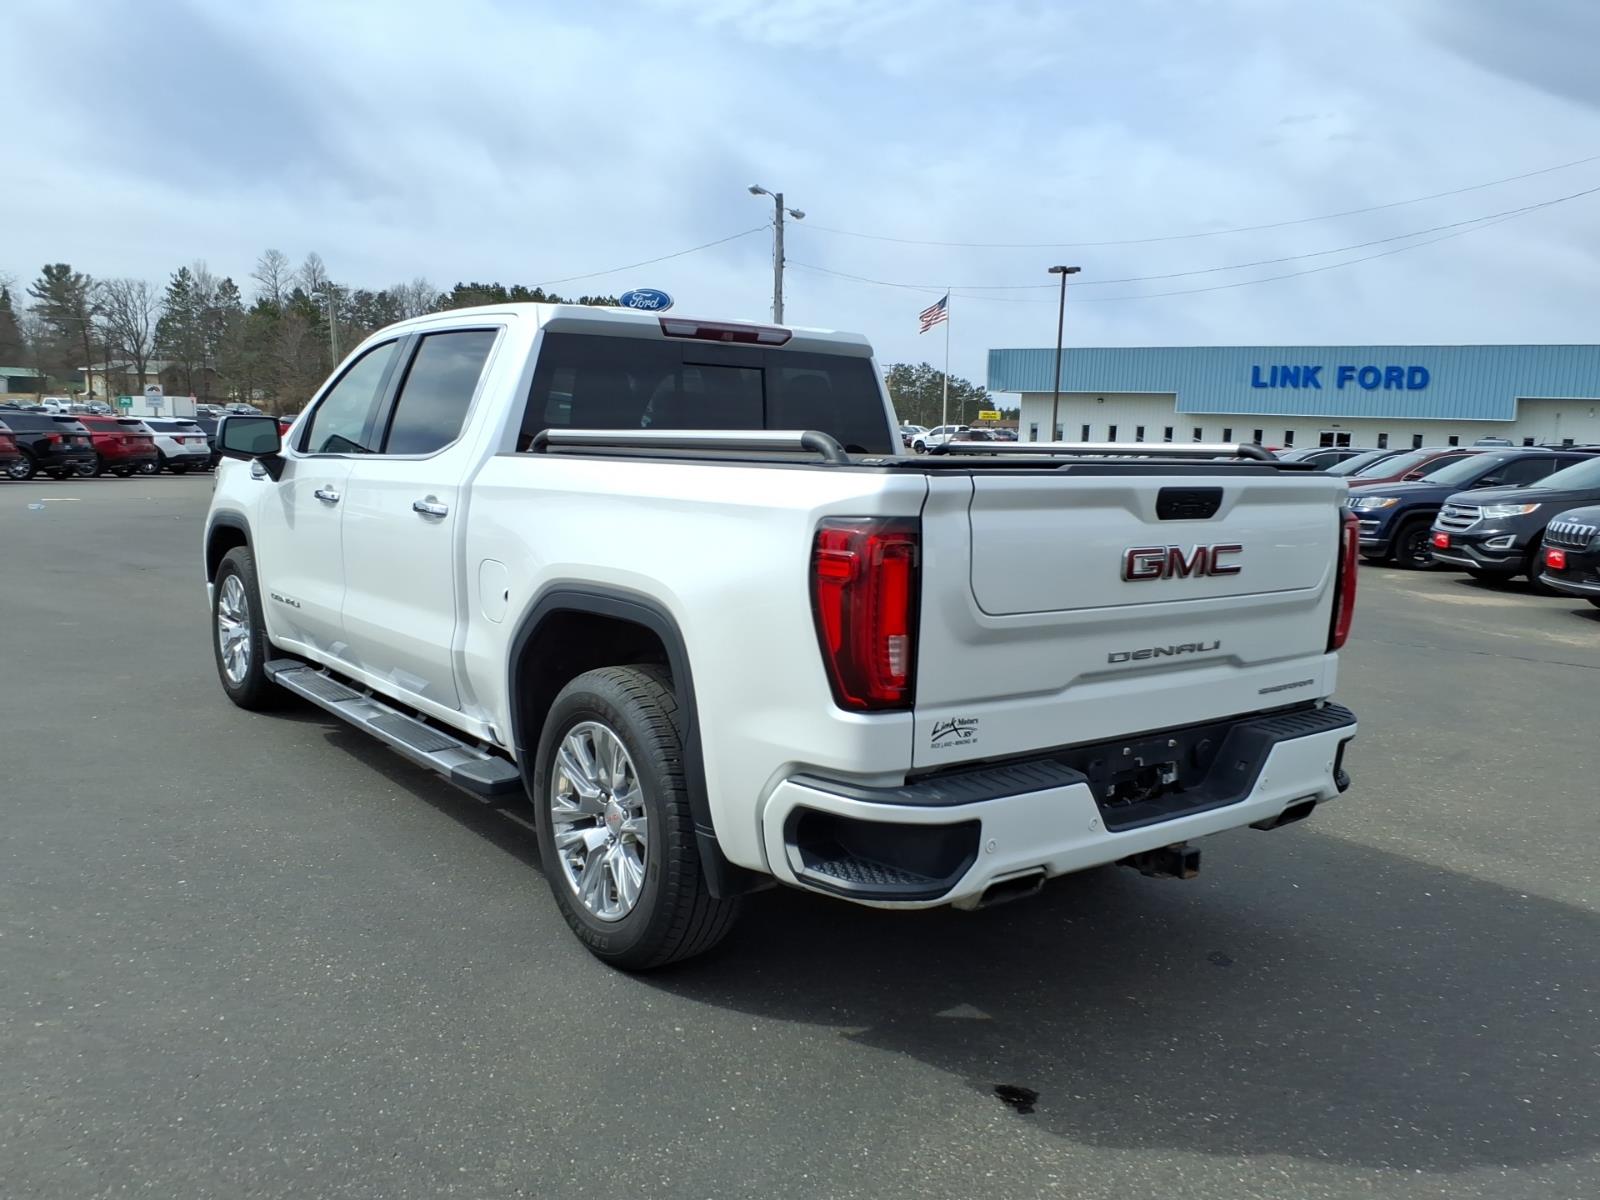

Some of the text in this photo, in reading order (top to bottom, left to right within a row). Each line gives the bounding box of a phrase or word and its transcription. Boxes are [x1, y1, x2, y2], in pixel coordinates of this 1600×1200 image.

[629, 292, 660, 308] Ford
[1252, 365, 1430, 390] LINK FORD
[1121, 543, 1243, 582] GMC
[1107, 639, 1221, 664] DENALI
